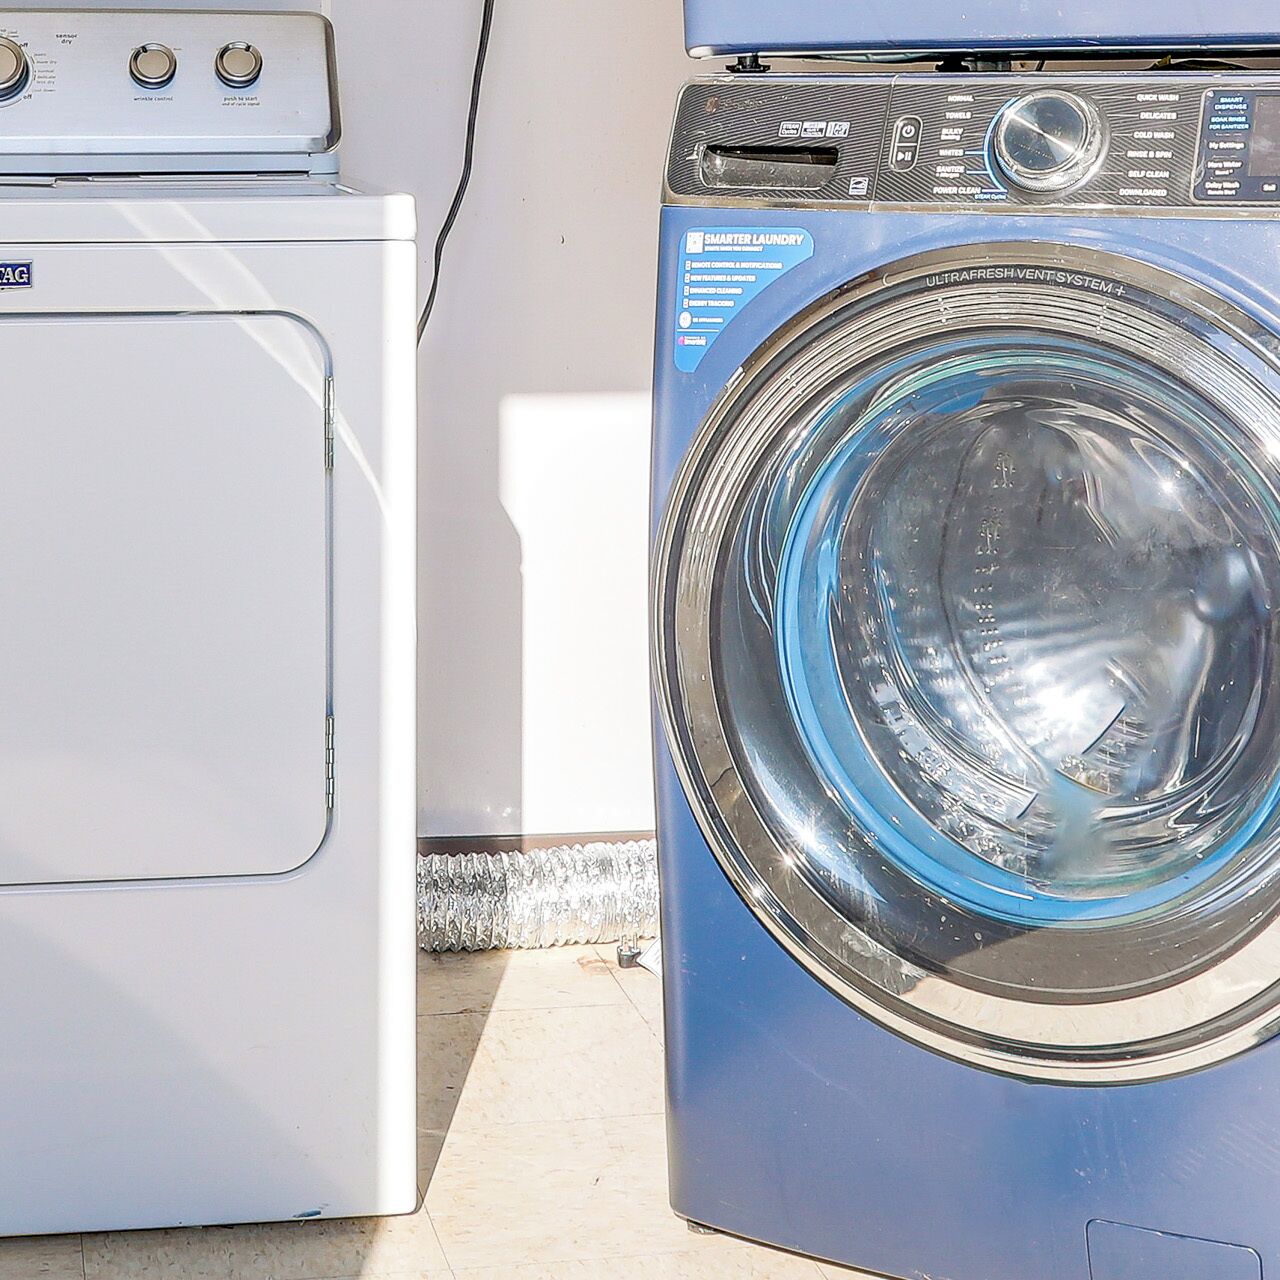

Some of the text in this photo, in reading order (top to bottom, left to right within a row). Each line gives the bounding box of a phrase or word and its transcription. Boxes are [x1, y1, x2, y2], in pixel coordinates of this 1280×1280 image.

[1136, 94, 1158, 102] QUICK
[945, 111, 972, 119] TOWELS
[1153, 131, 1175, 139] WASH
[1208, 141, 1245, 150] My Settings
[1128, 170, 1170, 178] SELF CLEAN
[1205, 181, 1222, 189] Delay
[1119, 188, 1168, 197] DOWNLOADED
[705, 233, 805, 245] SMARTER LAUNDRY
[926, 268, 1126, 296] ULTRAFRESH VENT SYSTEM +
